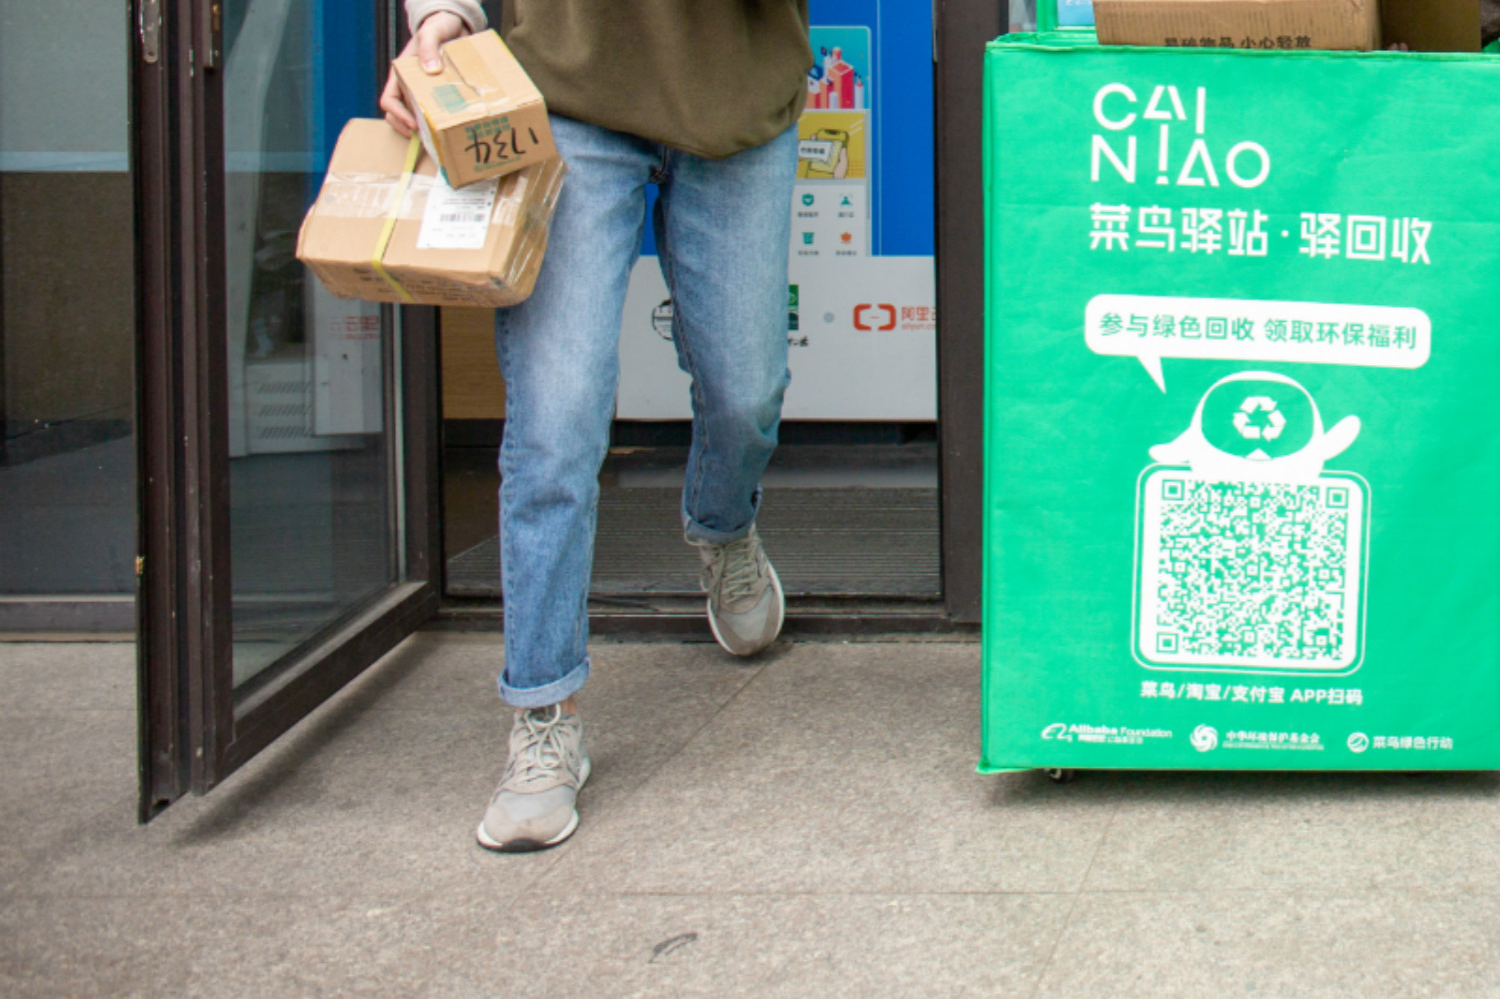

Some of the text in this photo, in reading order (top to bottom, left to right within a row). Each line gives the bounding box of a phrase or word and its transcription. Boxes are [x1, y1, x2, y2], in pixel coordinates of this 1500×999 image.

[1240, 35, 1312, 50] 小心轻放
[1092, 82, 1207, 135] CAI
[1099, 312, 1418, 350] 参与绿色回收 领取环保福利
[1140, 680, 1364, 706] 菜鸟/淘宝/支付宝 APP扫码
[1068, 724, 1173, 739] Alibaba Foundation
[1372, 735, 1454, 751] 菜鸟绿色行动
